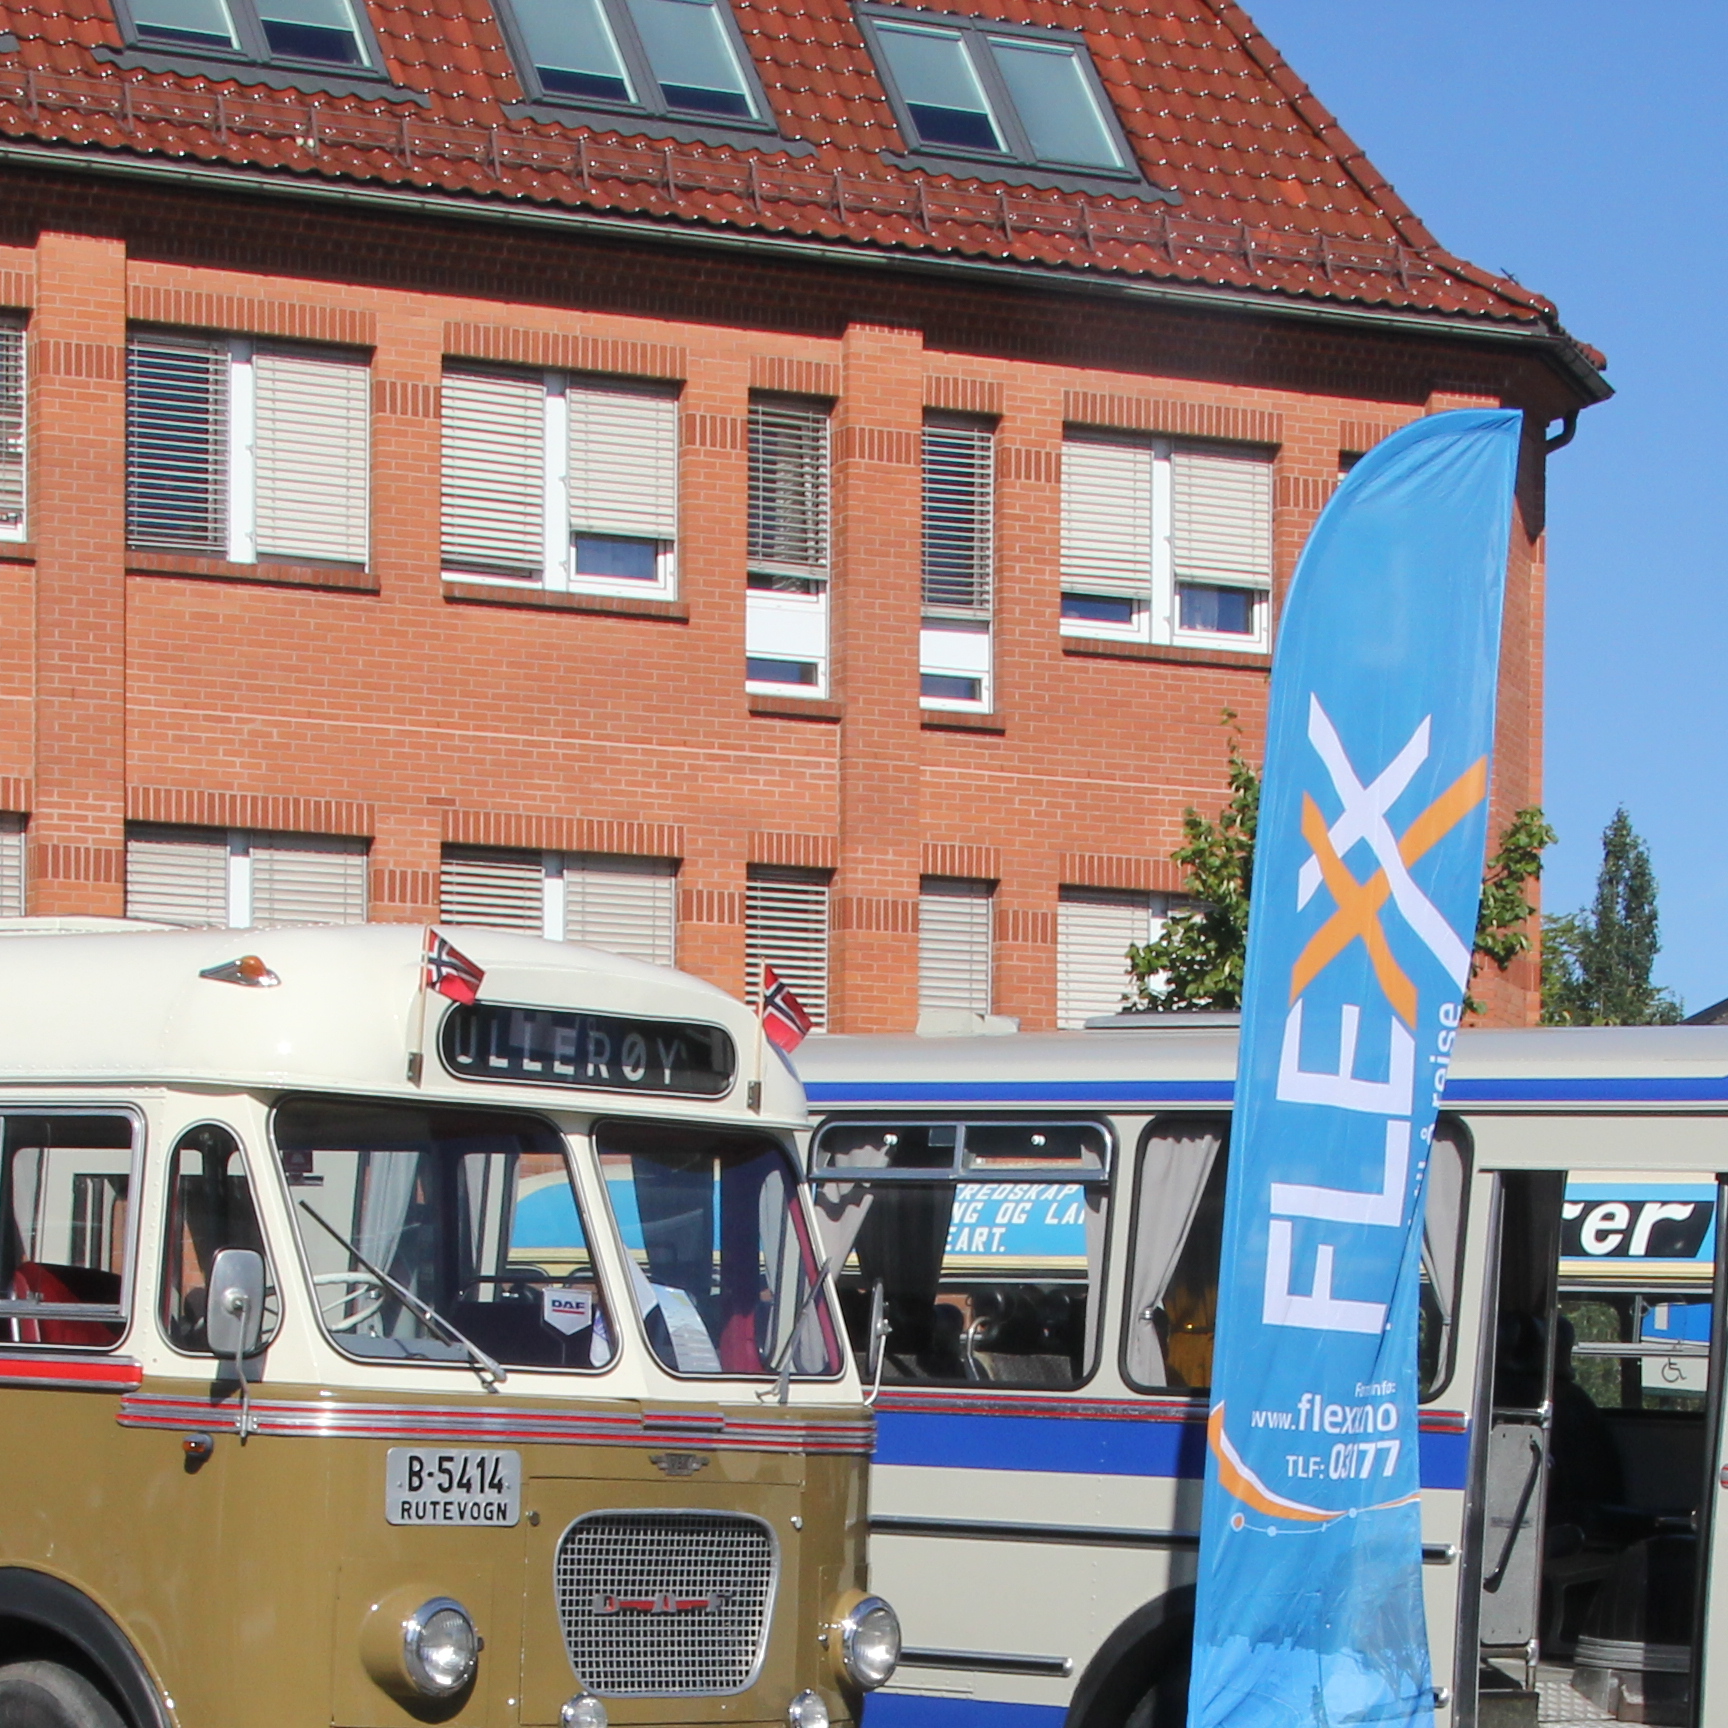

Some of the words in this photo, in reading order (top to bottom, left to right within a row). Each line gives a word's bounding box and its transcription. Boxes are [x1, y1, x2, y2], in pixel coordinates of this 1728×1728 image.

[1261, 691, 1488, 1335] FLEXX
[454, 1013, 684, 1085] ULLERØY
[957, 1184, 1079, 1200] REDSKAP
[995, 1202, 1033, 1224] OG
[1044, 1202, 1085, 1225] LA
[1562, 1202, 1696, 1256] er
[551, 1299, 586, 1312] DAF
[407, 1455, 504, 1495] B-5414
[1285, 1455, 1326, 1480] TLF:
[1328, 1439, 1401, 1480] 03177
[400, 1500, 508, 1521] RUTEVOGN
